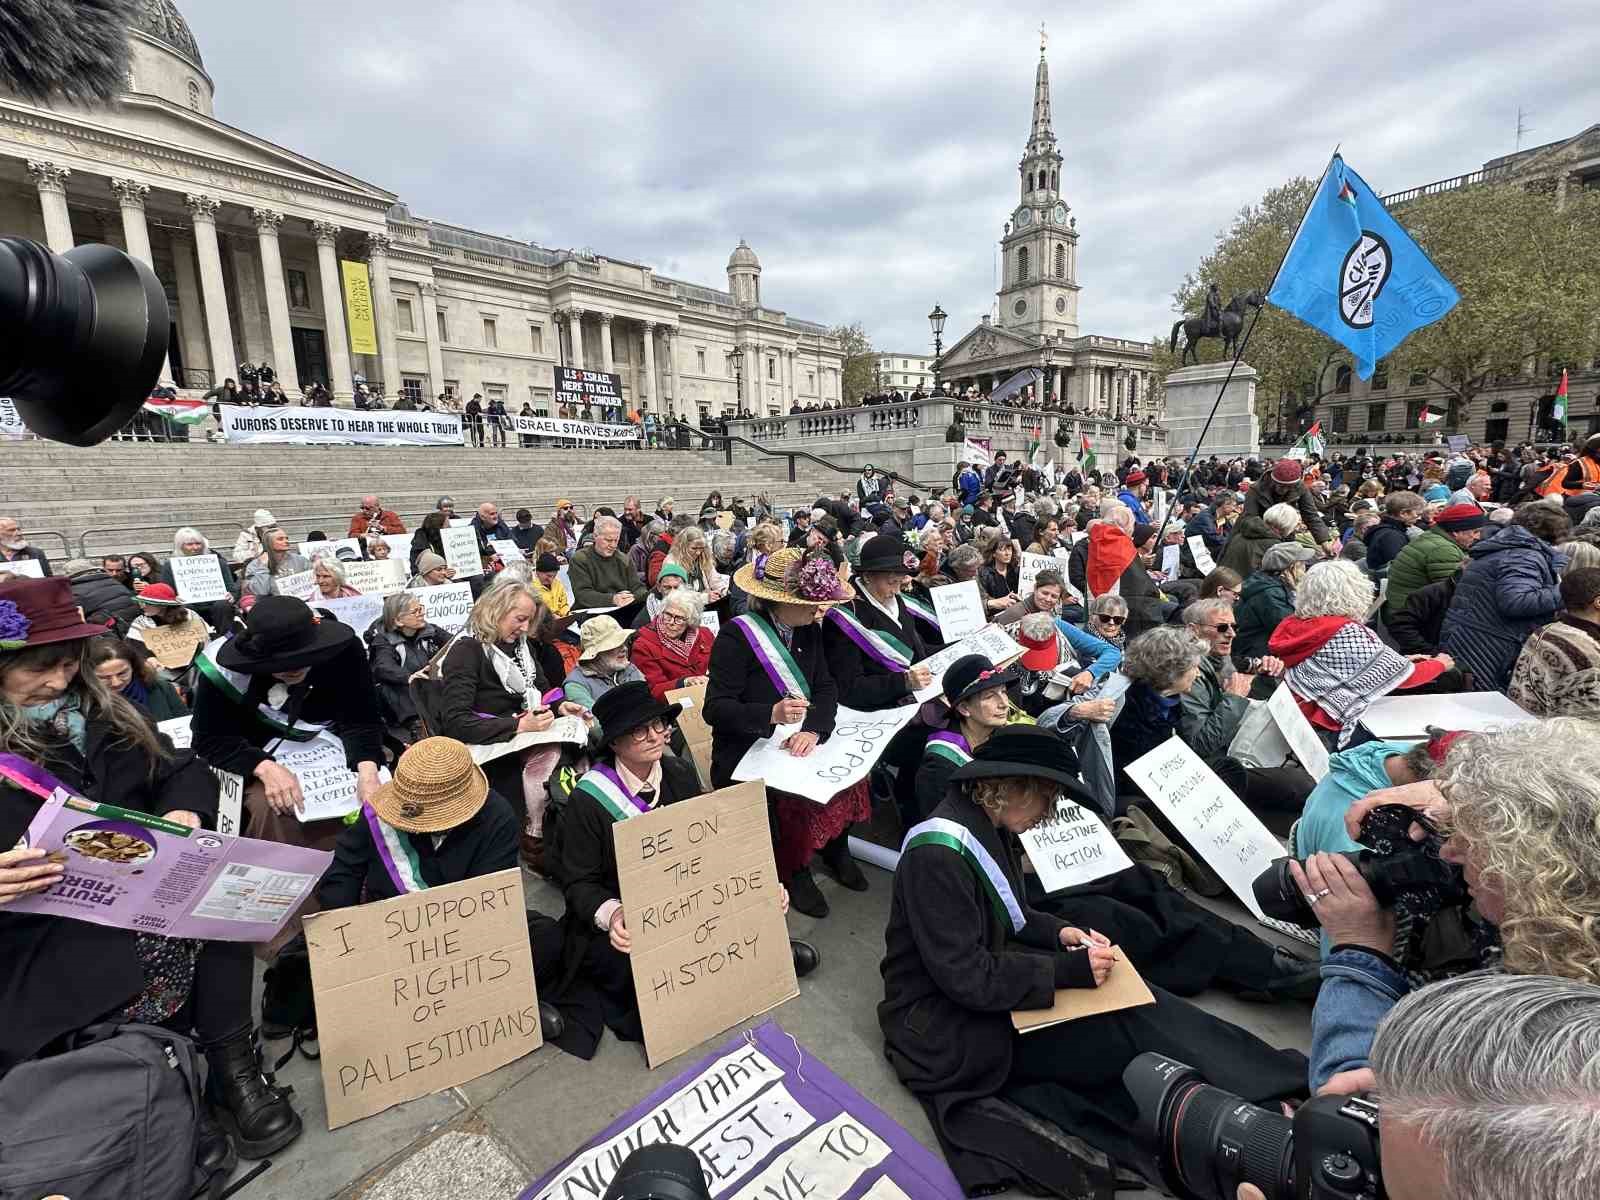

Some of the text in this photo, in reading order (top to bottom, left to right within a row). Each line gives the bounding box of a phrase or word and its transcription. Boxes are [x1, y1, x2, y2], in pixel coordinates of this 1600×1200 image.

[562, 381, 616, 395] HERE TO KILL
[583, 370, 612, 384] ISRAEL
[556, 392, 583, 403] STEAL
[591, 396, 622, 406] CONQUER
[232, 418, 458, 435] JURORS DESERVE TO HEAR THE WHOLE TRUTH
[516, 420, 560, 432] ISRAEL
[562, 424, 610, 438] STARVES
[430, 590, 470, 604] OPPOSE
[426, 602, 474, 618] ENOCIDE
[1148, 770, 1164, 792] I
[314, 785, 358, 804] ACTIO
[641, 816, 718, 860] BE ON
[1032, 824, 1100, 848] PALESTINE
[1054, 844, 1104, 870] ACTION
[664, 856, 702, 886] THE
[52, 886, 116, 906] FRUIT
[642, 871, 762, 936] RIGHT SIDE
[333, 884, 516, 958] I SUPPORT
[694, 916, 720, 944] OF
[404, 929, 461, 964] THE
[394, 950, 511, 1007] RIGHTS
[652, 933, 759, 1000] HISTORY
[413, 1000, 446, 1022] OF
[338, 1006, 538, 1096] PALESTINIANS
[537, 1051, 767, 1200] NOUGH THAT
[820, 1124, 868, 1161] TO
